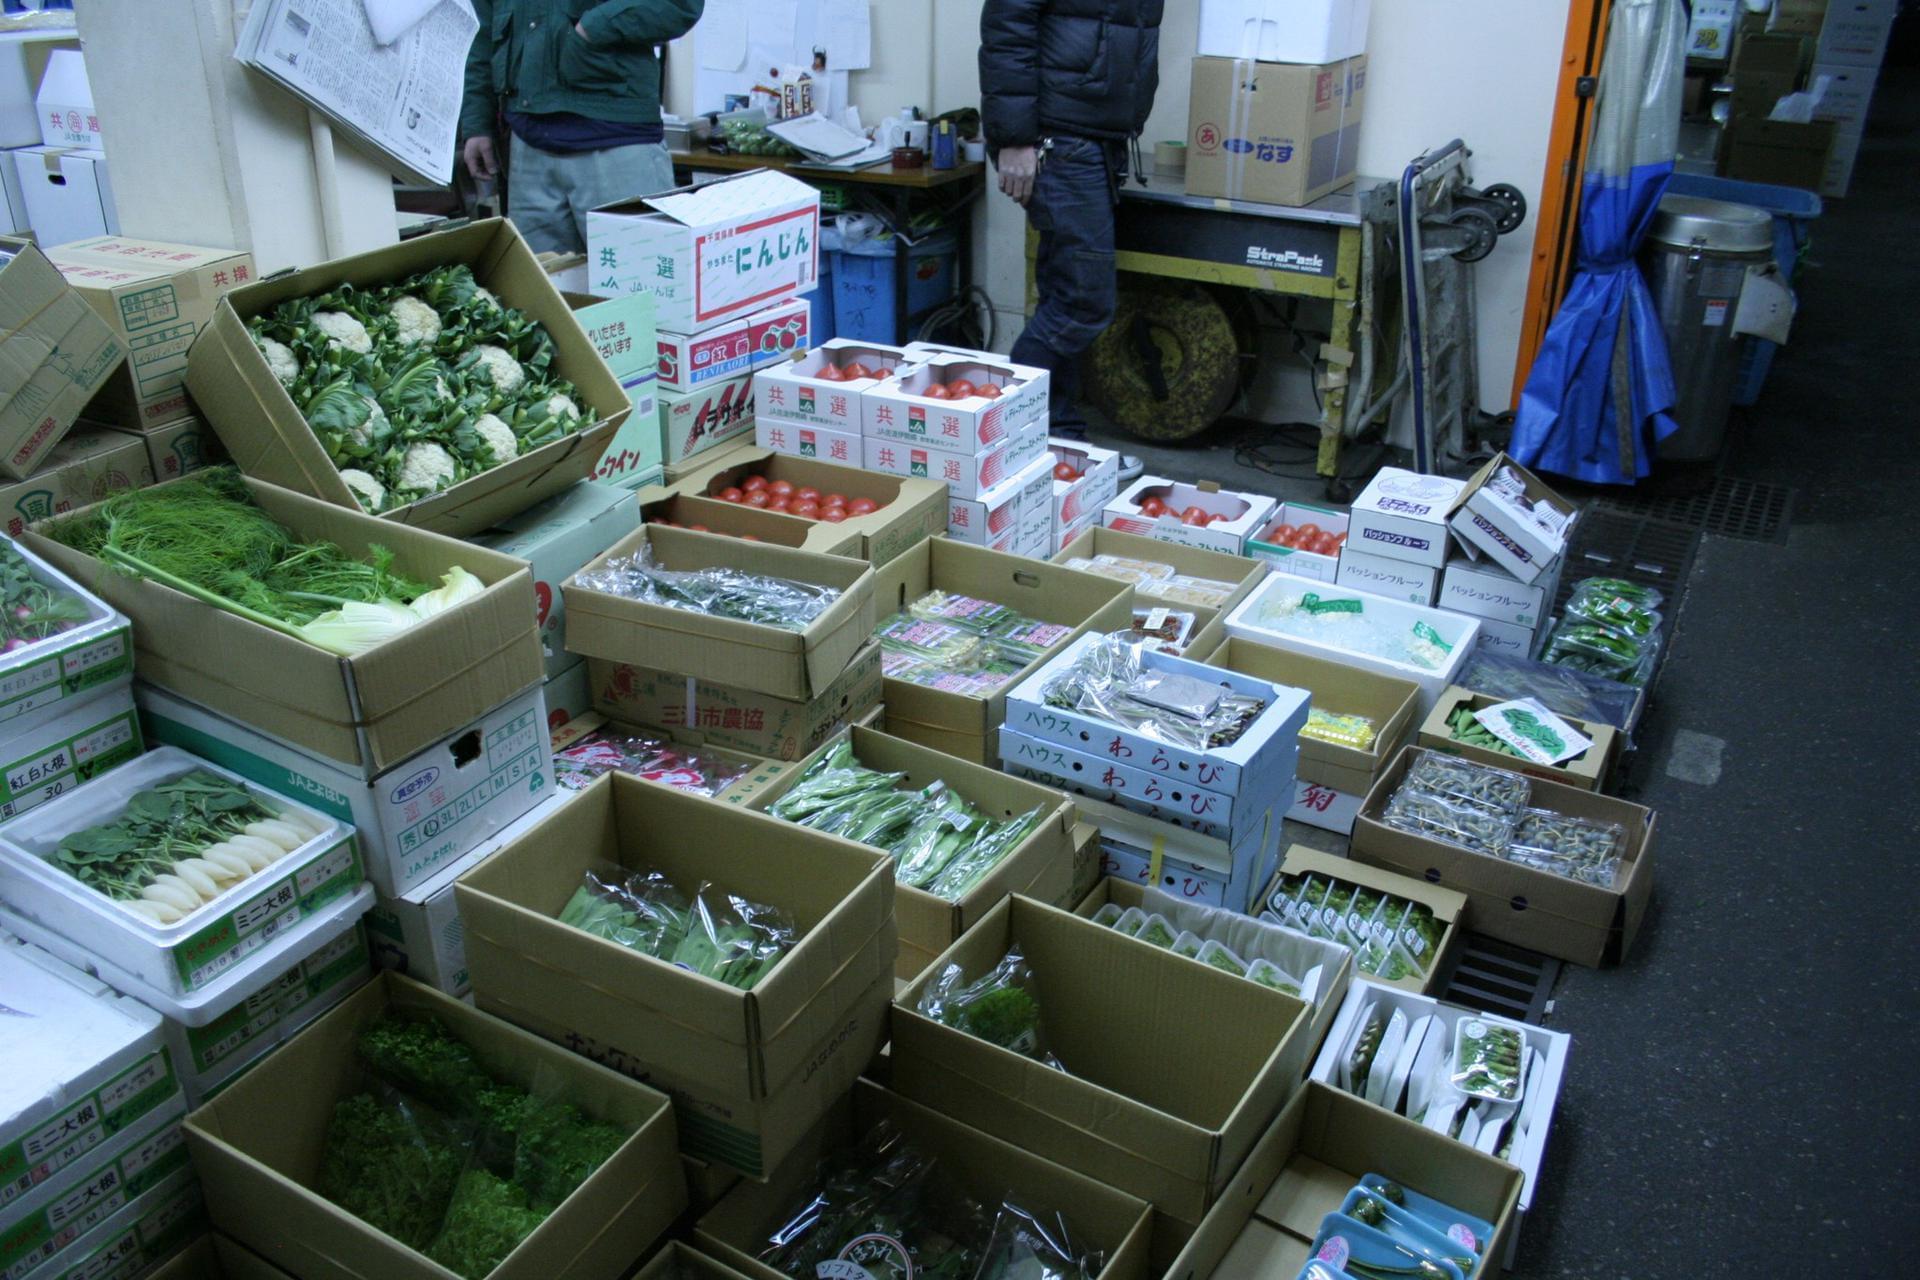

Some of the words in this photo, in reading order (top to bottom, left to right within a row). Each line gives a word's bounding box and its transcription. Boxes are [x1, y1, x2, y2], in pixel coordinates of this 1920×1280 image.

[1201, 128, 1215, 145] あ
[1256, 145, 1294, 163] なす
[736, 227, 809, 275] にんじん
[1247, 246, 1323, 267] StraPack
[768, 386, 784, 406] 共
[830, 395, 847, 417] 選
[877, 405, 893, 426] 共
[942, 416, 960, 438] 選
[769, 429, 785, 448] 共
[831, 439, 848, 460] 選
[879, 448, 895, 468] 共
[944, 459, 960, 481] 選
[952, 505, 968, 527] 選
[1364, 529, 1429, 550] パッションフルーツ
[1474, 515, 1532, 563] パッションフルーツ
[1347, 566, 1424, 589] パッションフルーツ
[1450, 584, 1532, 609] パッションフルーツ
[1025, 711, 1073, 737] ハウス
[1108, 736, 1224, 785] わらび
[10, 753, 67, 792] 紅白大根
[1018, 743, 1067, 769] ハウス
[1102, 767, 1217, 815] わらび
[44, 782, 62, 801] 30
[288, 772, 346, 806] JAとよはし
[441, 811, 455, 825] 3L
[460, 799, 473, 814] 2L
[478, 788, 488, 801] L
[494, 776, 505, 790] M
[512, 765, 521, 778] S
[528, 755, 538, 768] A
[237, 885, 293, 929] ミニ大根
[28, 1105, 95, 1156] ミニ大根
[64, 1147, 76, 1159] M
[88, 1133, 97, 1143] S
[53, 1171, 117, 1223] ミニ大根
[86, 1212, 97, 1223] M
